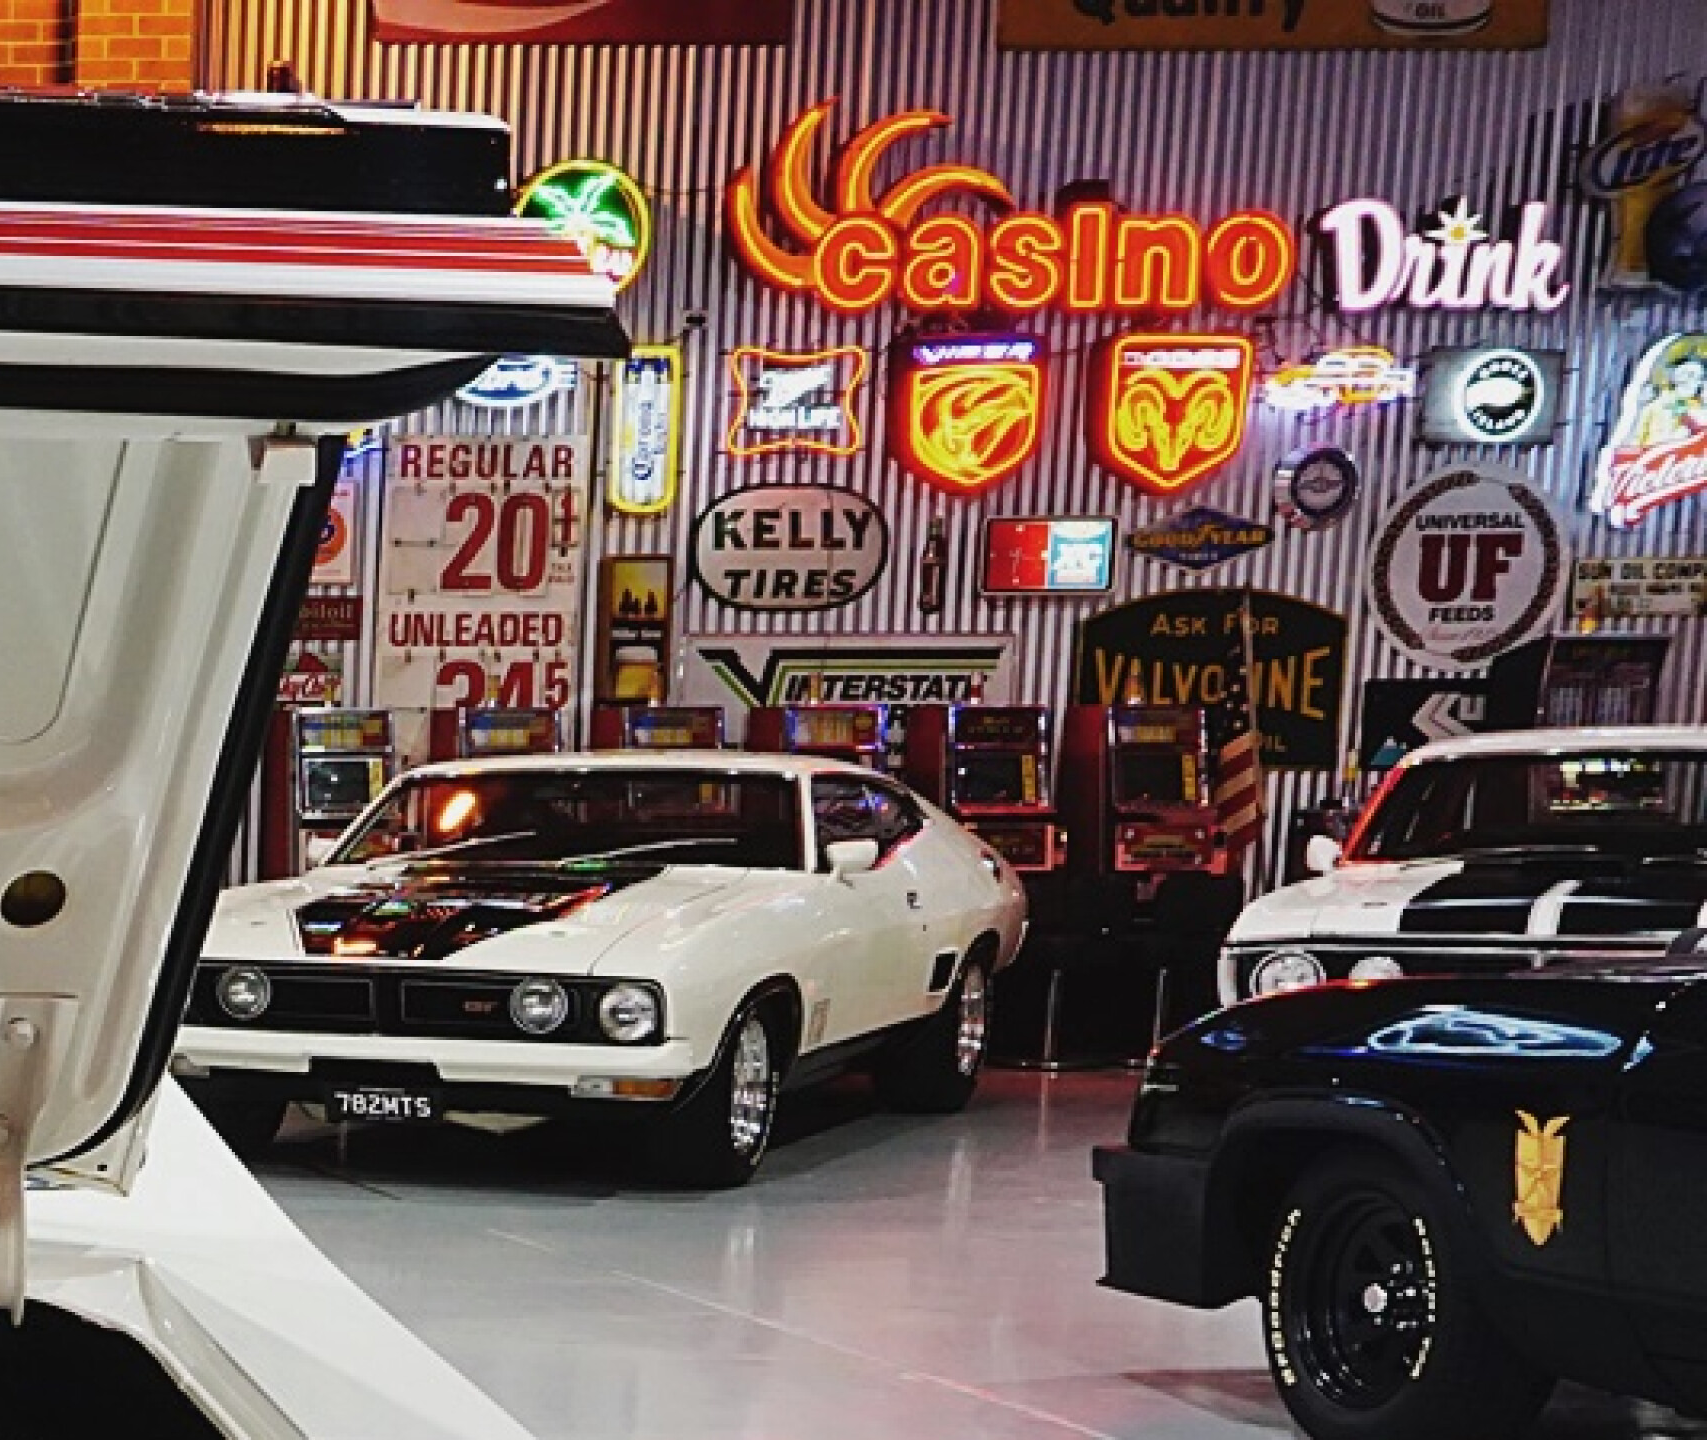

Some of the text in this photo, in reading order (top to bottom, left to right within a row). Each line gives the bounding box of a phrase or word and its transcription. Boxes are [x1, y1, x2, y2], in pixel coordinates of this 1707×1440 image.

[813, 205, 1297, 309] casino
[1320, 198, 1570, 313] Drink
[400, 443, 574, 479] REGULAR
[710, 508, 872, 551] KELLY
[1416, 512, 1525, 531] UNIVERSAL
[439, 491, 548, 592] 20
[722, 568, 857, 599] TIRES
[1417, 530, 1525, 602] UF
[388, 612, 564, 647] UNLEADED
[1150, 613, 1207, 637] ASK
[1428, 605, 1495, 623] FEEDS
[333, 1090, 432, 1119] 782MTS
